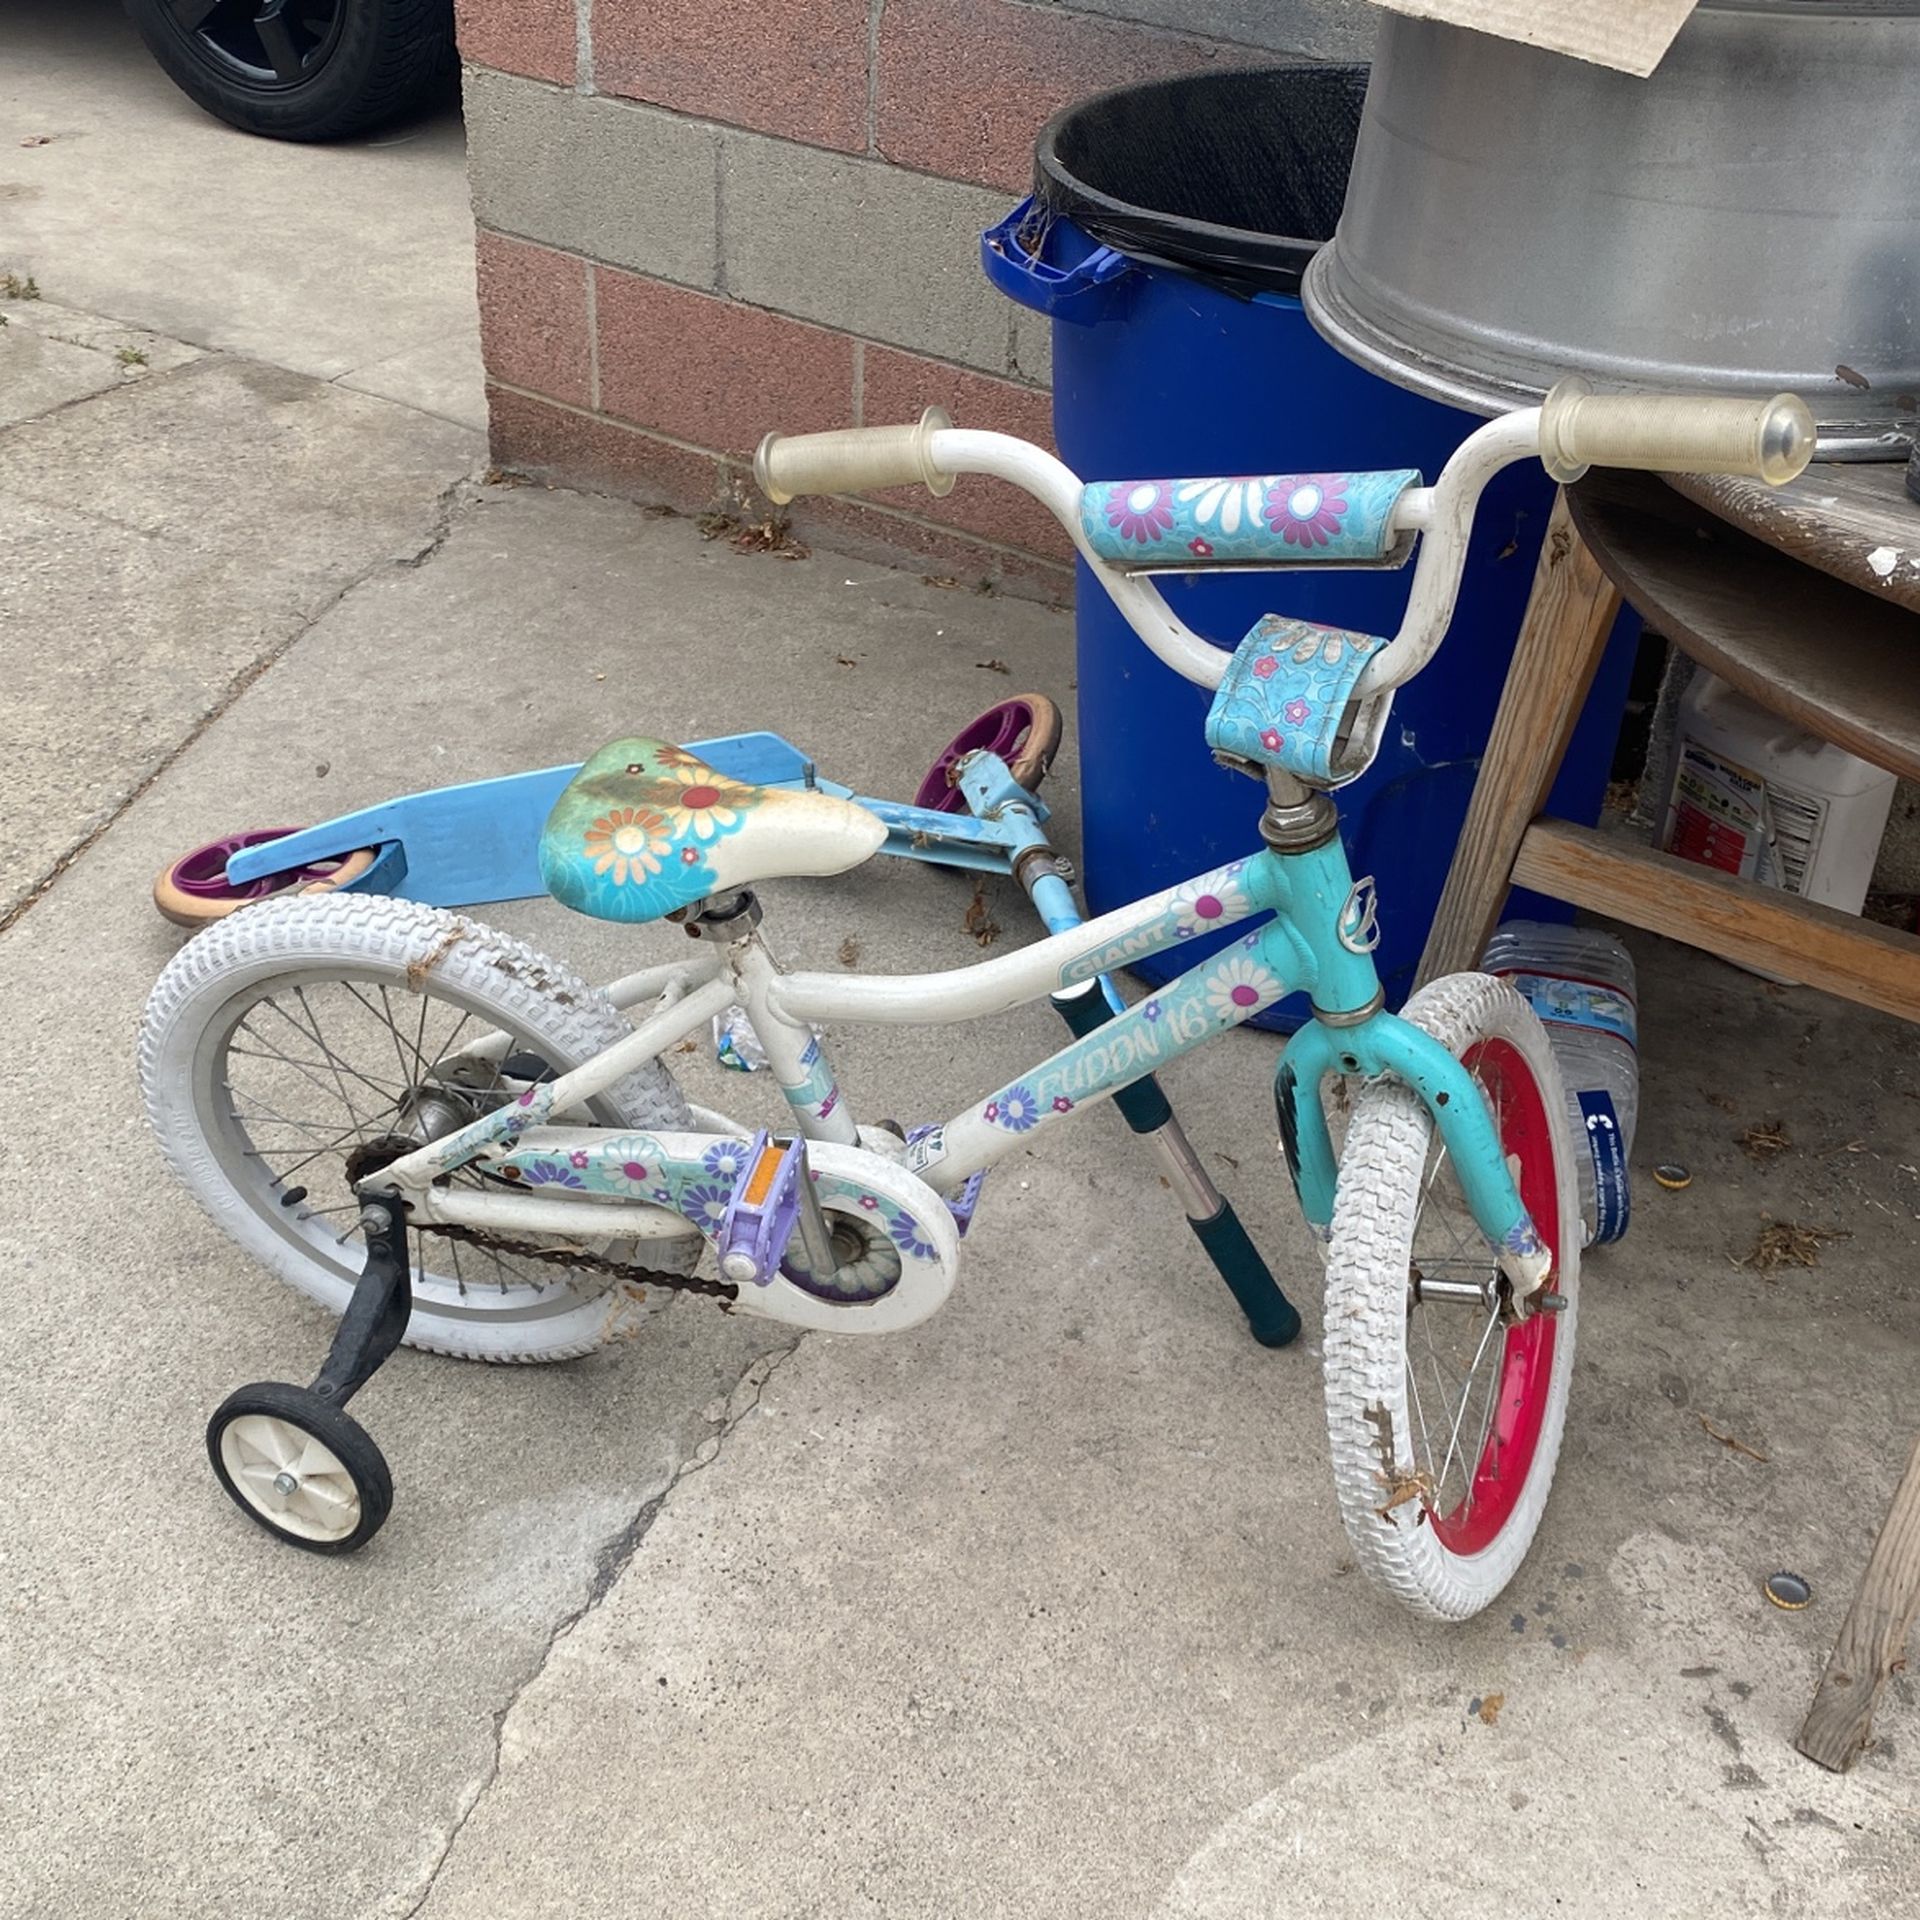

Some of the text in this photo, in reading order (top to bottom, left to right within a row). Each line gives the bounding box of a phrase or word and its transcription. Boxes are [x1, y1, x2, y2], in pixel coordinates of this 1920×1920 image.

[1069, 922, 1166, 980] GIANT
[1166, 997, 1208, 1045] 16
[1608, 1133, 1616, 1147] This
